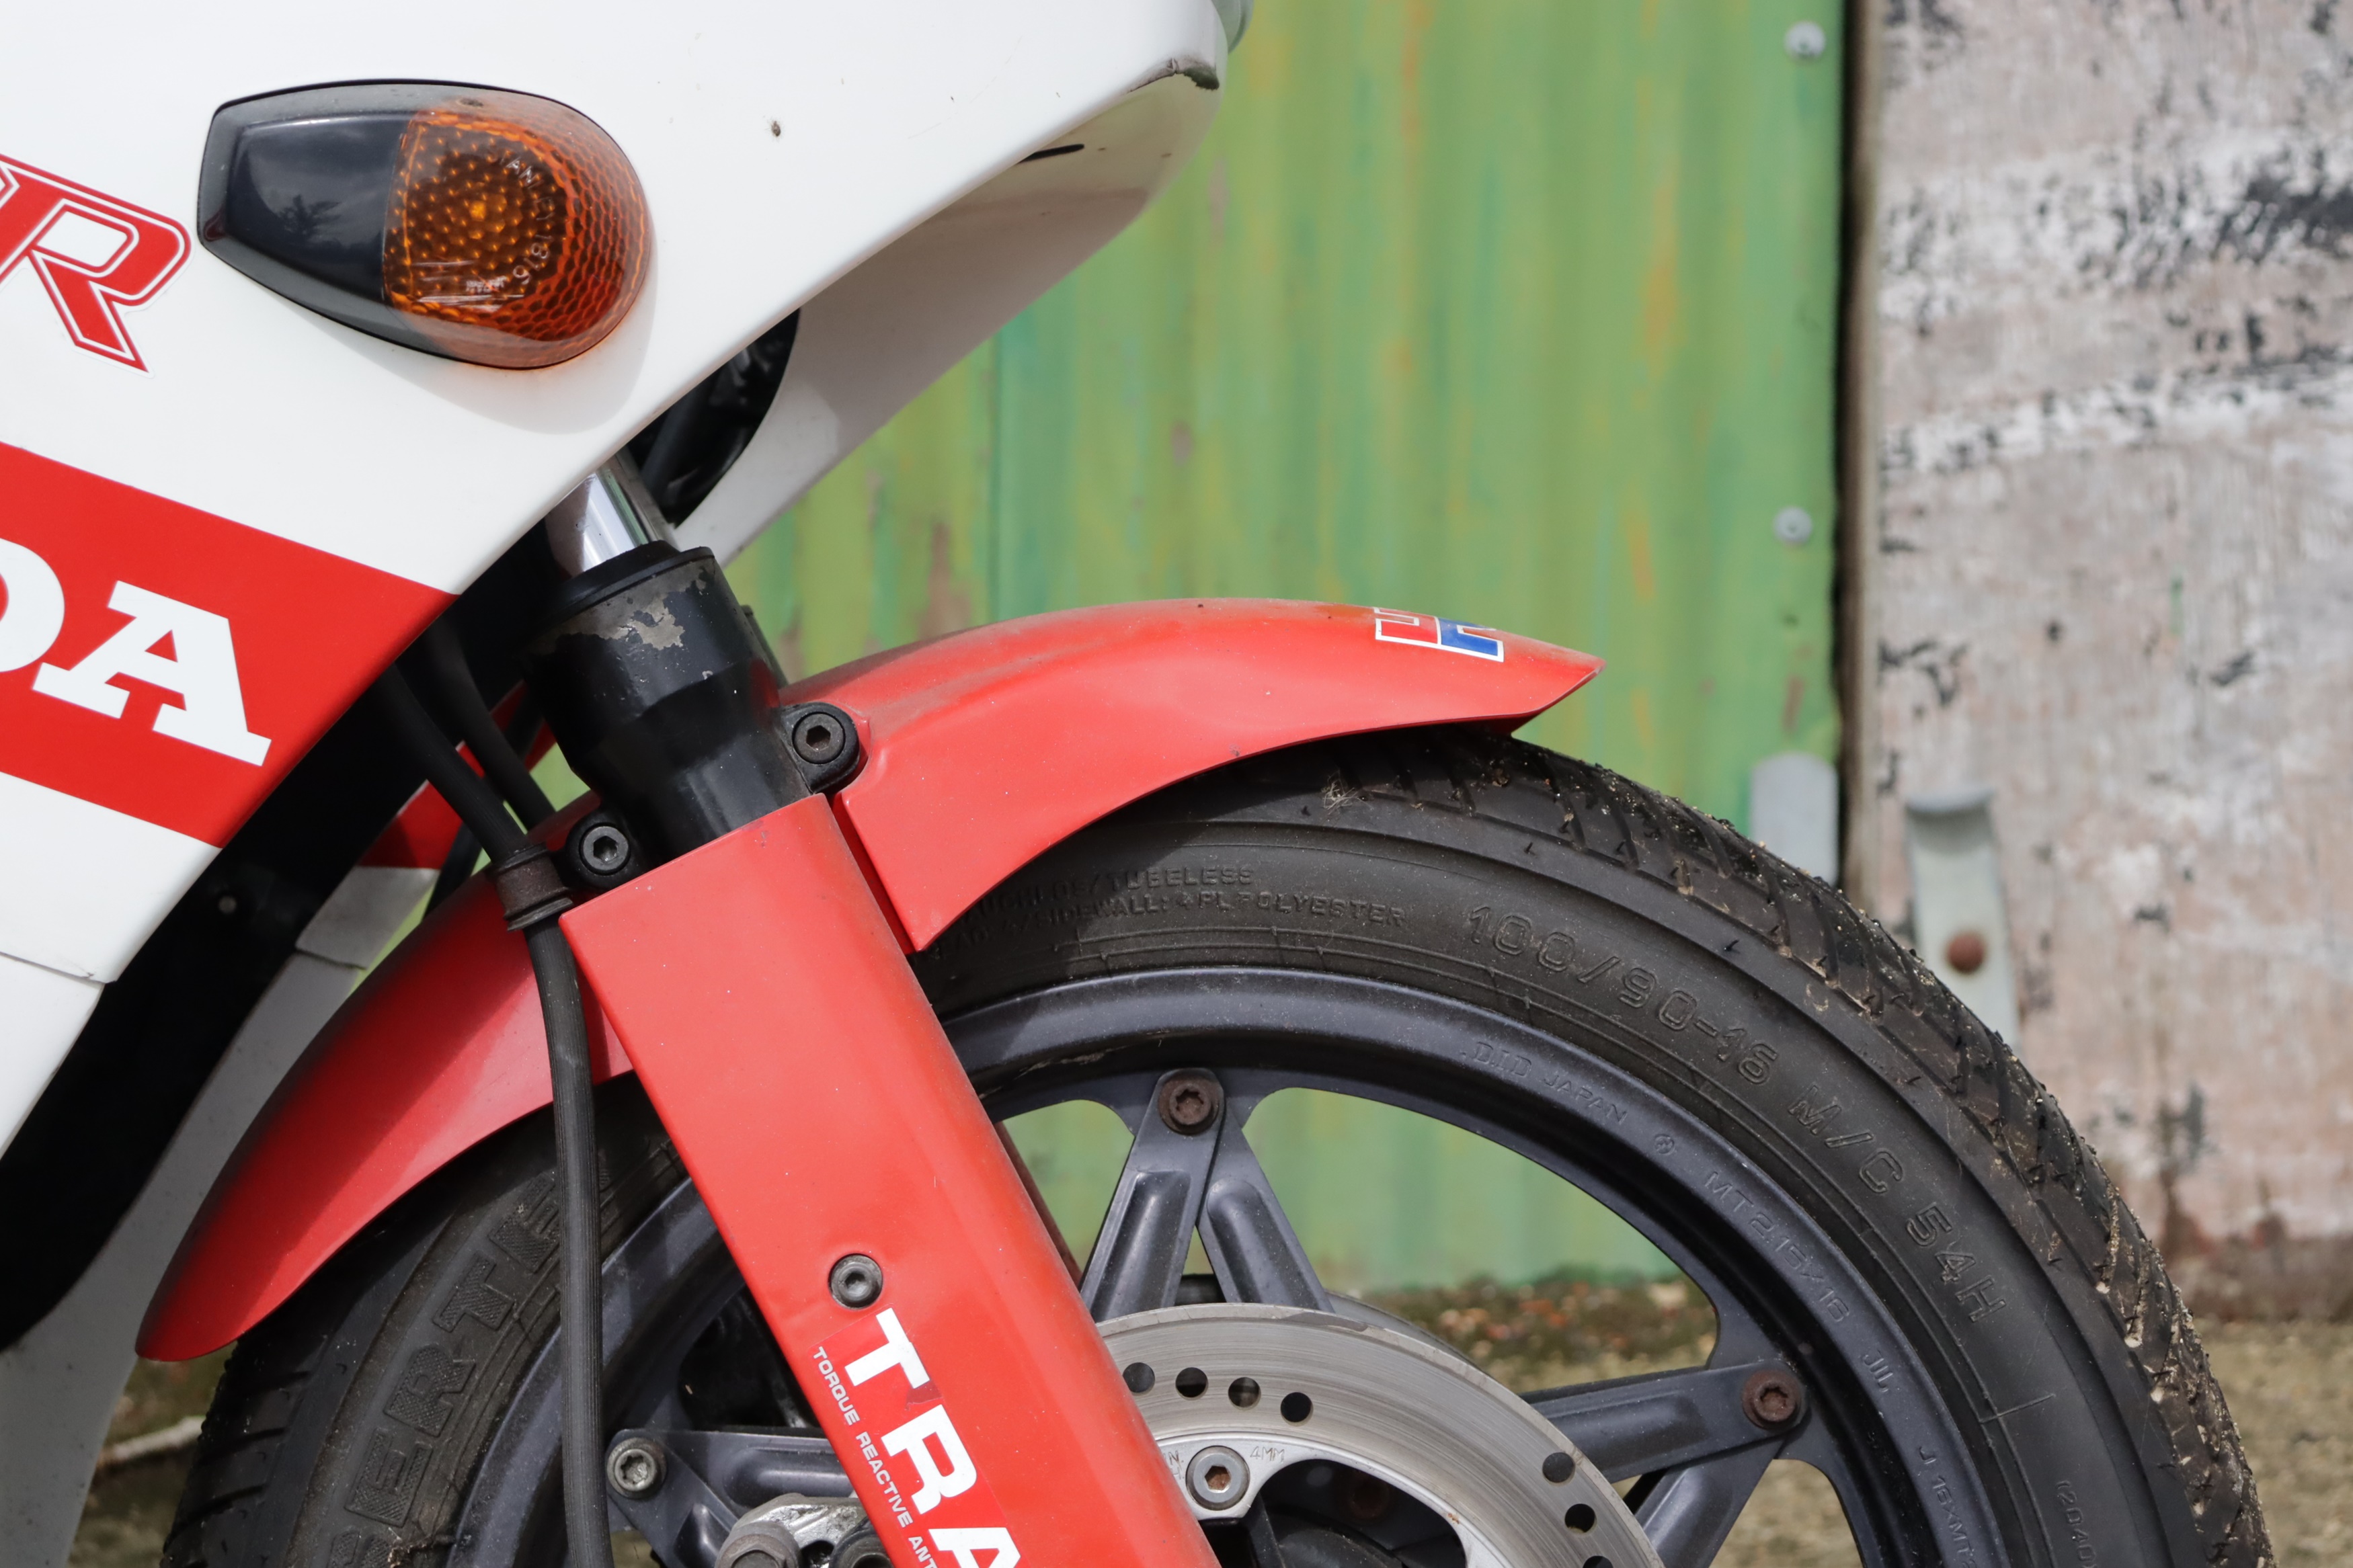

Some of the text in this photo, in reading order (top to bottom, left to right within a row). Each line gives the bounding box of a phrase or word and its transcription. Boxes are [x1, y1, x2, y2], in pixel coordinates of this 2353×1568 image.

[1466, 903, 2007, 1323] 100/90-16 M/C 54H
[1542, 1073, 1629, 1126] JAPAN
[813, 1346, 860, 1426] TORQUE
[855, 1432, 914, 1528] REACTIVE
